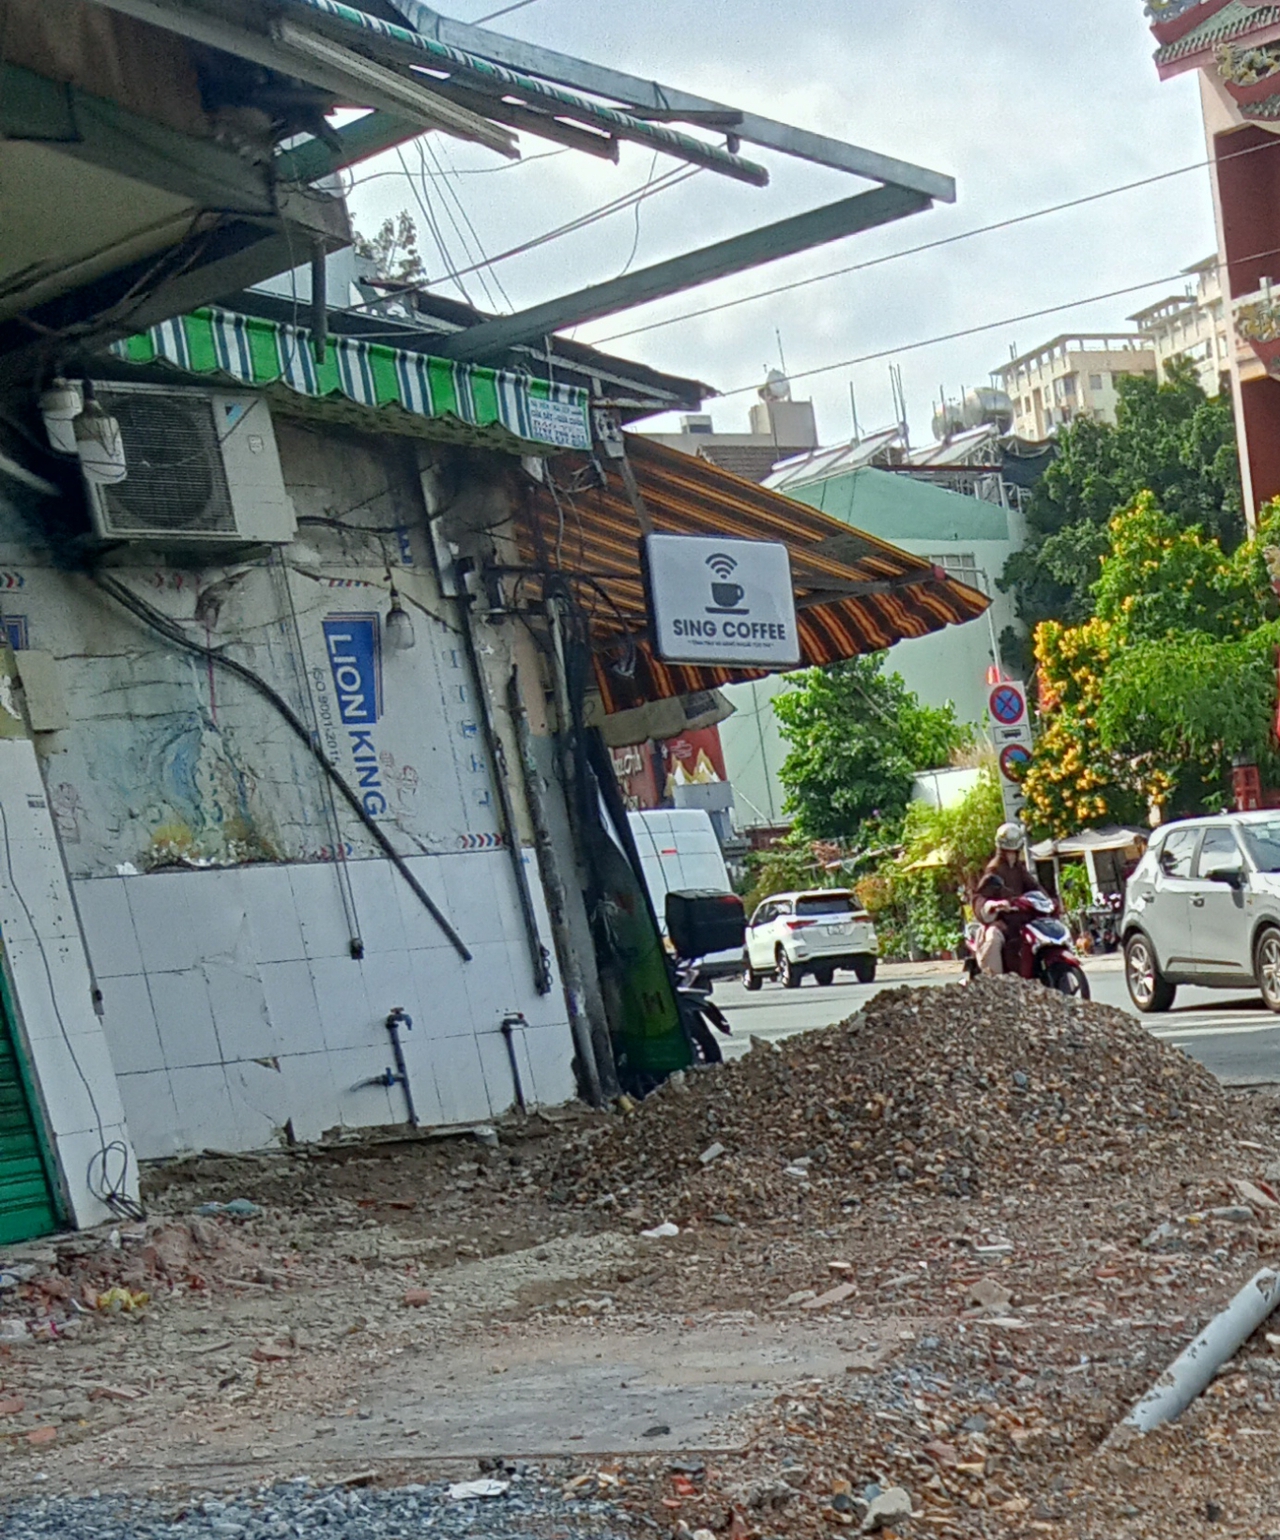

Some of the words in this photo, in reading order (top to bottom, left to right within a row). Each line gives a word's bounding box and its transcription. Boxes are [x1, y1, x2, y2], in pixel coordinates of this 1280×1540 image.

[673, 619, 717, 637] SING
[722, 621, 786, 641] COFFEE
[311, 667, 327, 692] ISO
[328, 634, 368, 718] LION
[348, 730, 387, 816] KING
